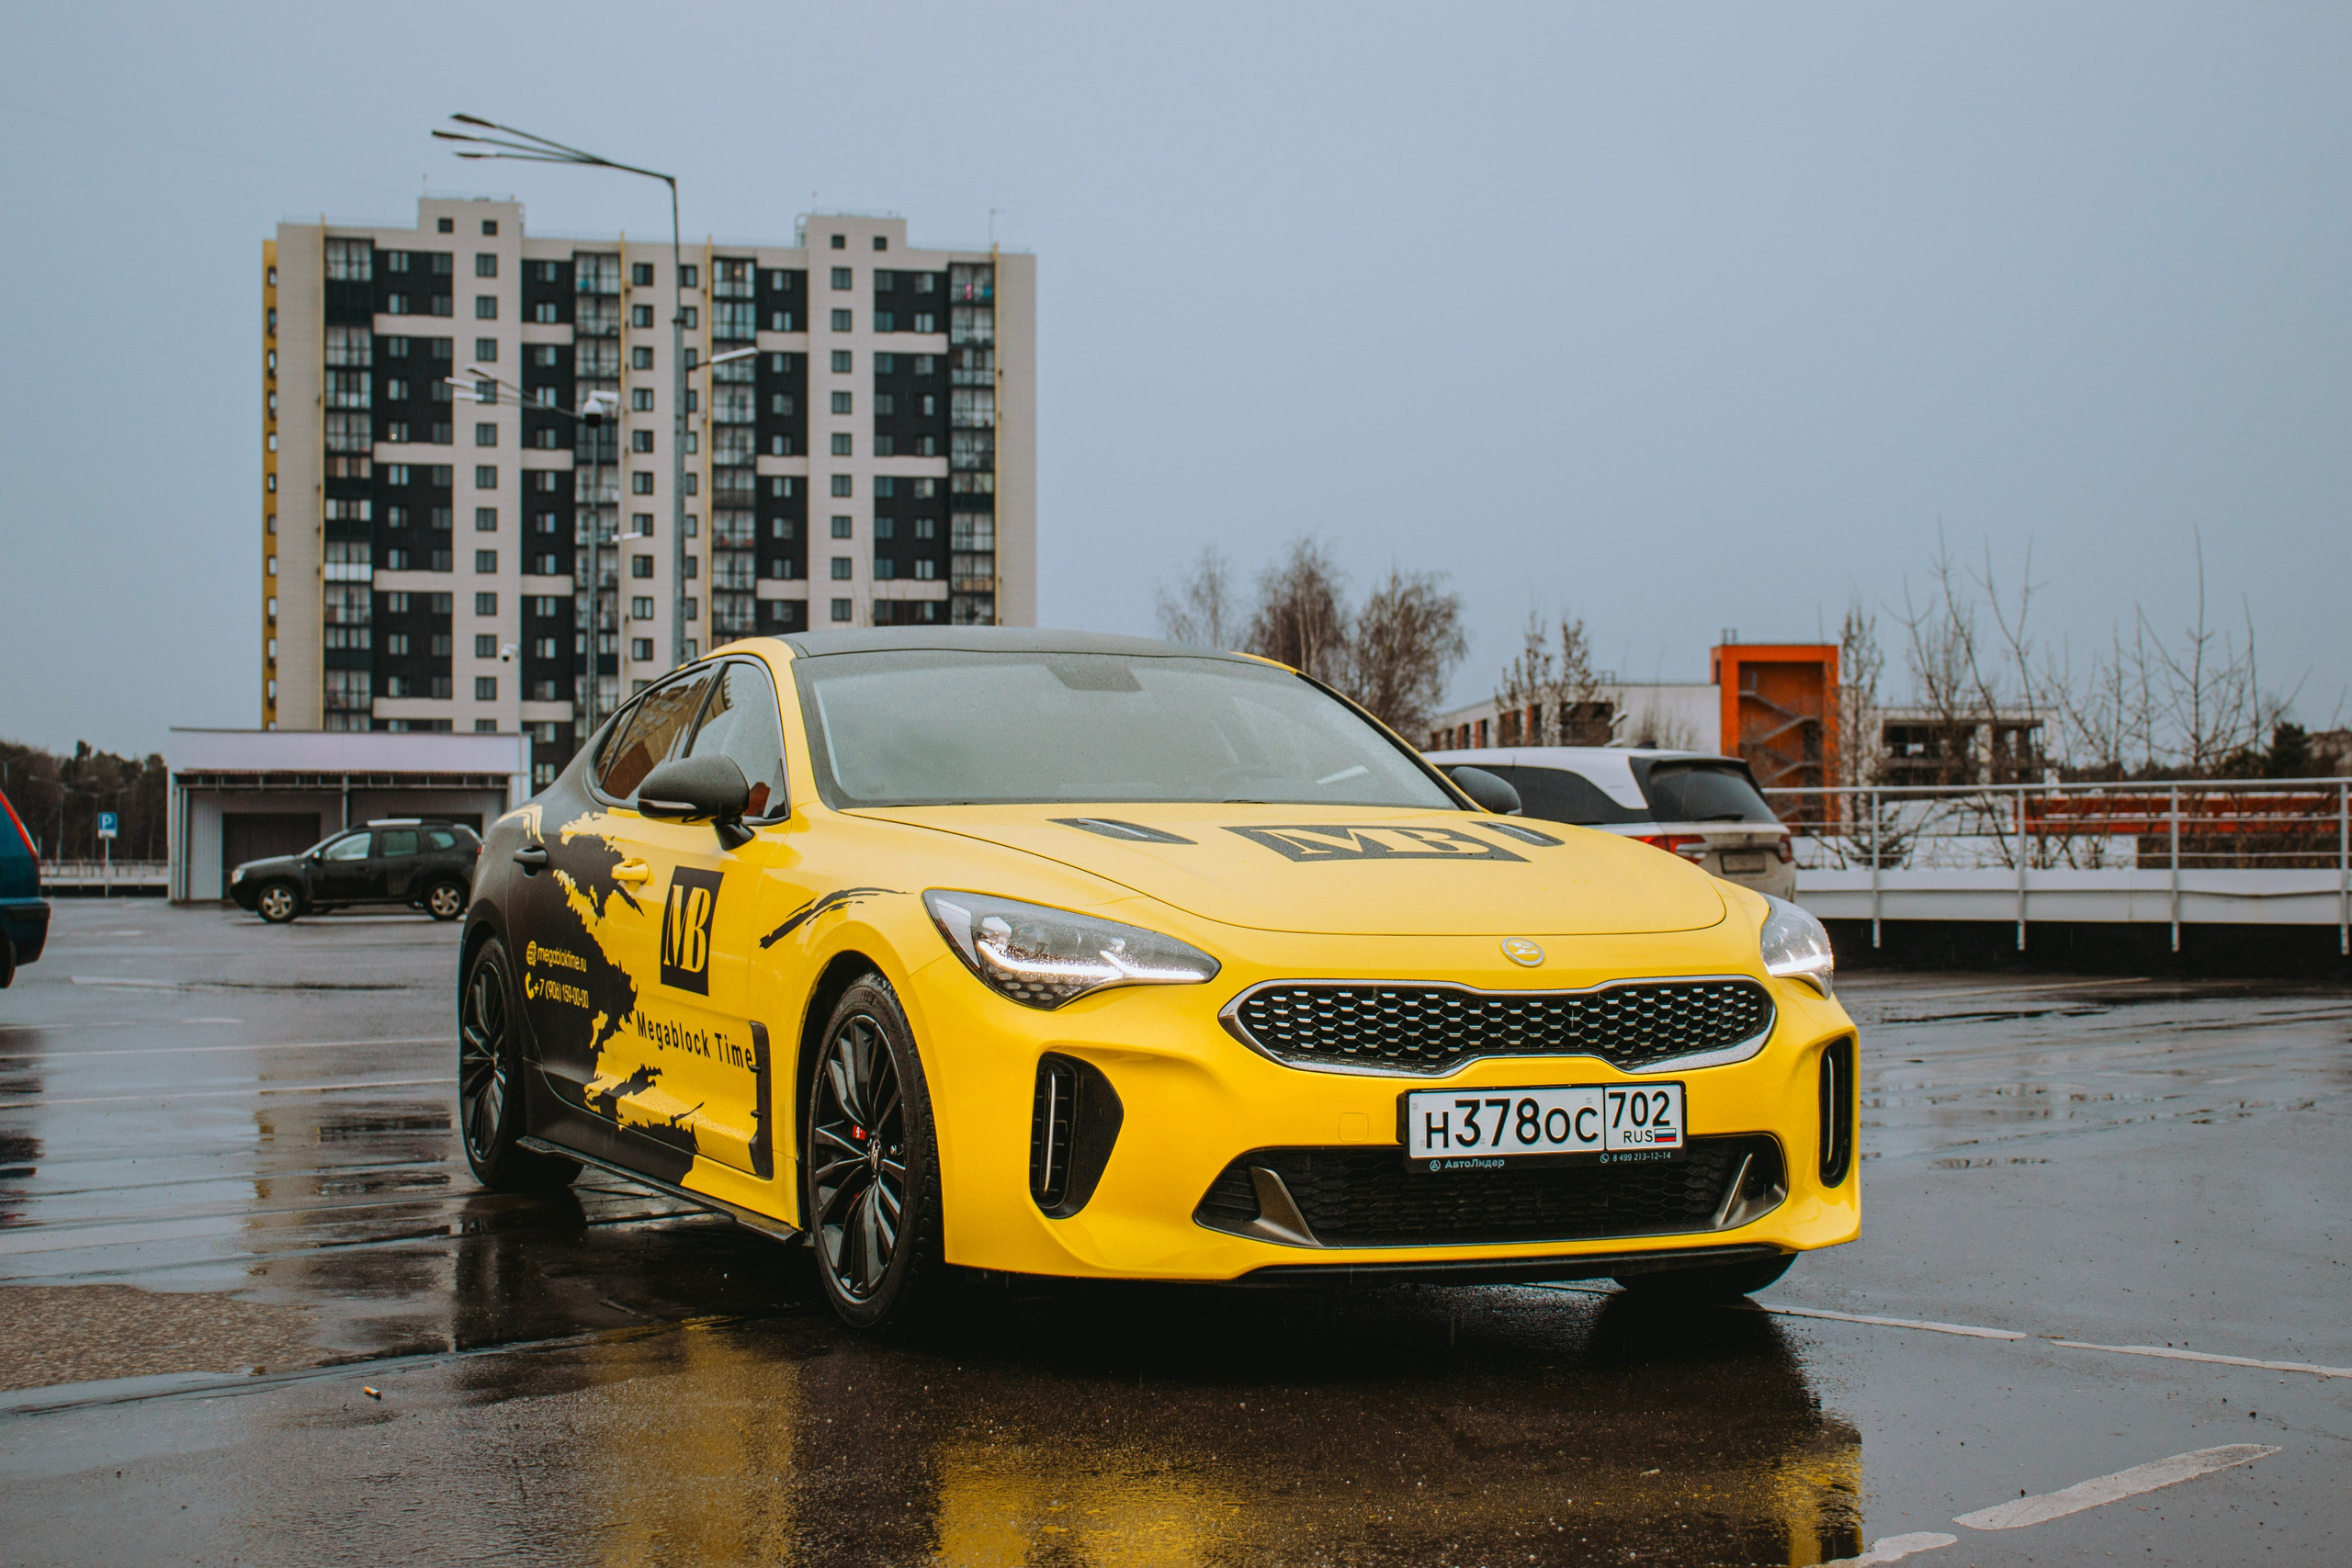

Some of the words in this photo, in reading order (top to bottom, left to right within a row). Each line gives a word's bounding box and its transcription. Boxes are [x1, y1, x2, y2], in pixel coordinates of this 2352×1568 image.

[1271, 829, 1489, 854] MB
[663, 885, 711, 974] MB
[534, 978, 545, 997] +7
[637, 1010, 710, 1058] Megablock
[714, 1032, 754, 1070] Time
[1608, 1090, 1670, 1128] 702
[1623, 1130, 1653, 1144] RUS
[1444, 1158, 1505, 1169] АвтоЛидер
[1612, 1154, 1618, 1162] 8
[1619, 1153, 1633, 1162] 499
[1634, 1151, 1671, 1161] 213-12-14
